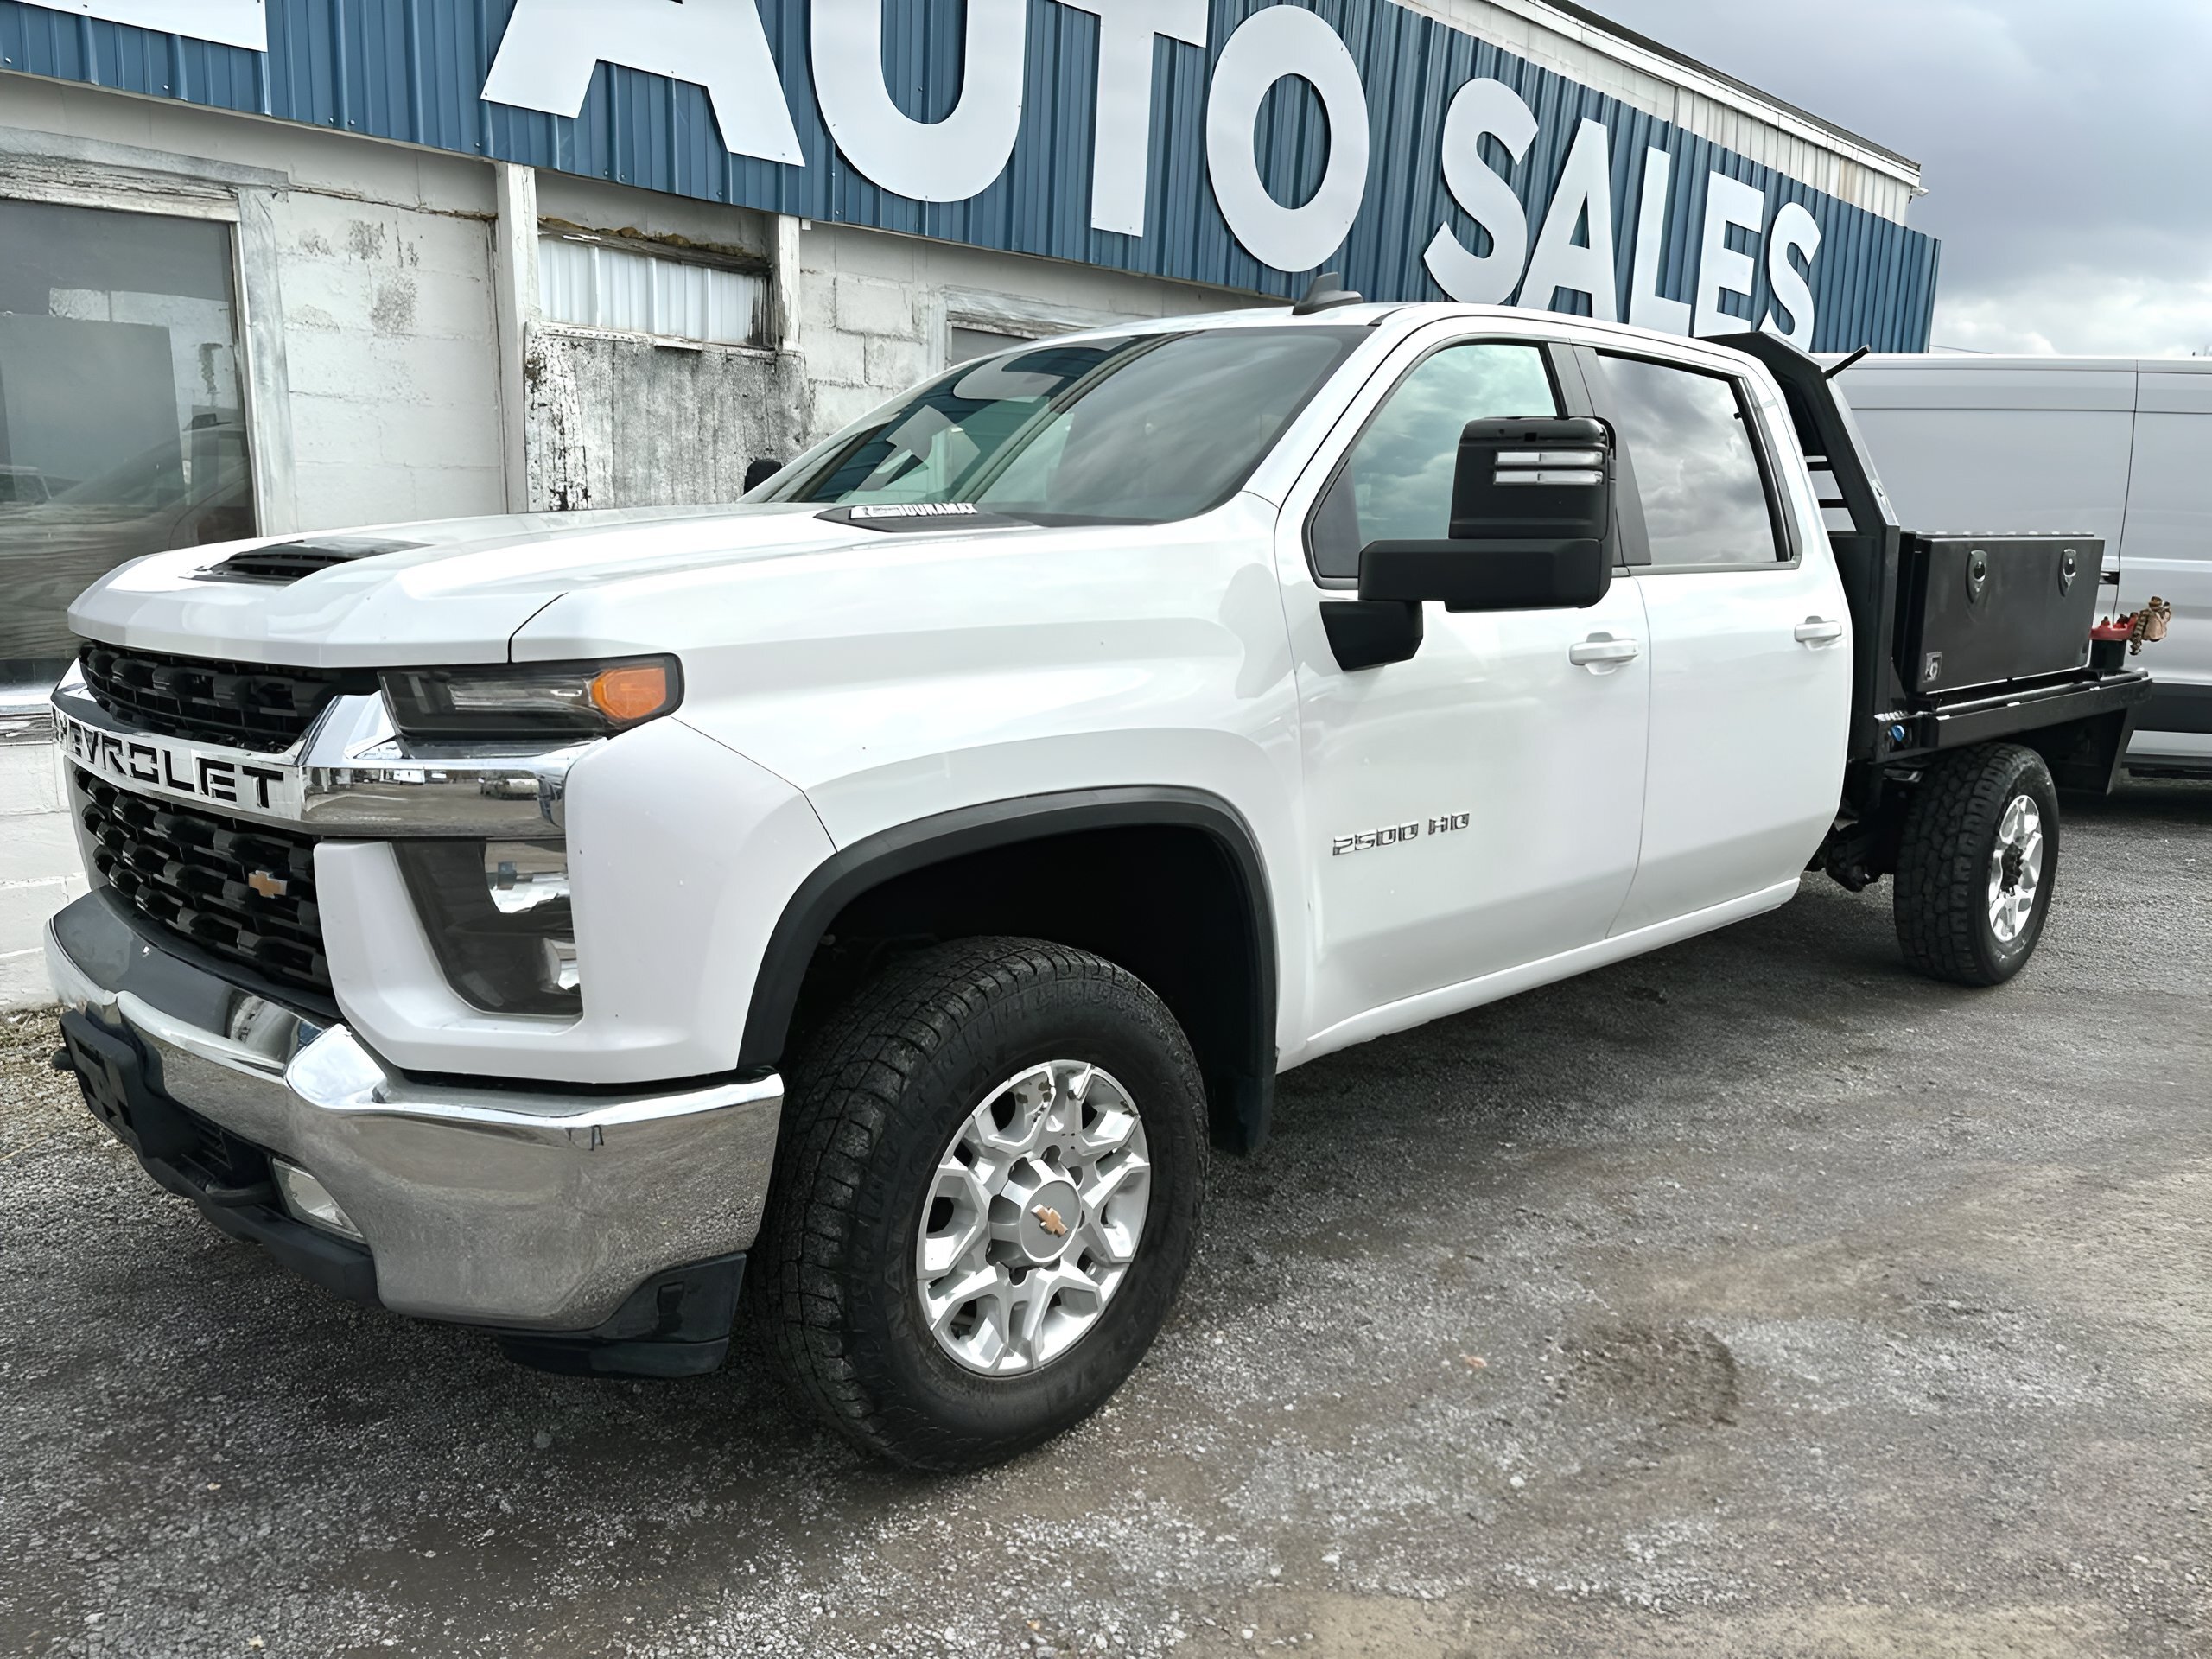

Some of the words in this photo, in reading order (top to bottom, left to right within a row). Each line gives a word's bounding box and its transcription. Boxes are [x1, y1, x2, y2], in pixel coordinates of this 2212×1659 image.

[1424, 77, 1822, 353] SALES
[1332, 820, 1420, 856] 2500
[1427, 810, 1471, 836] HD
